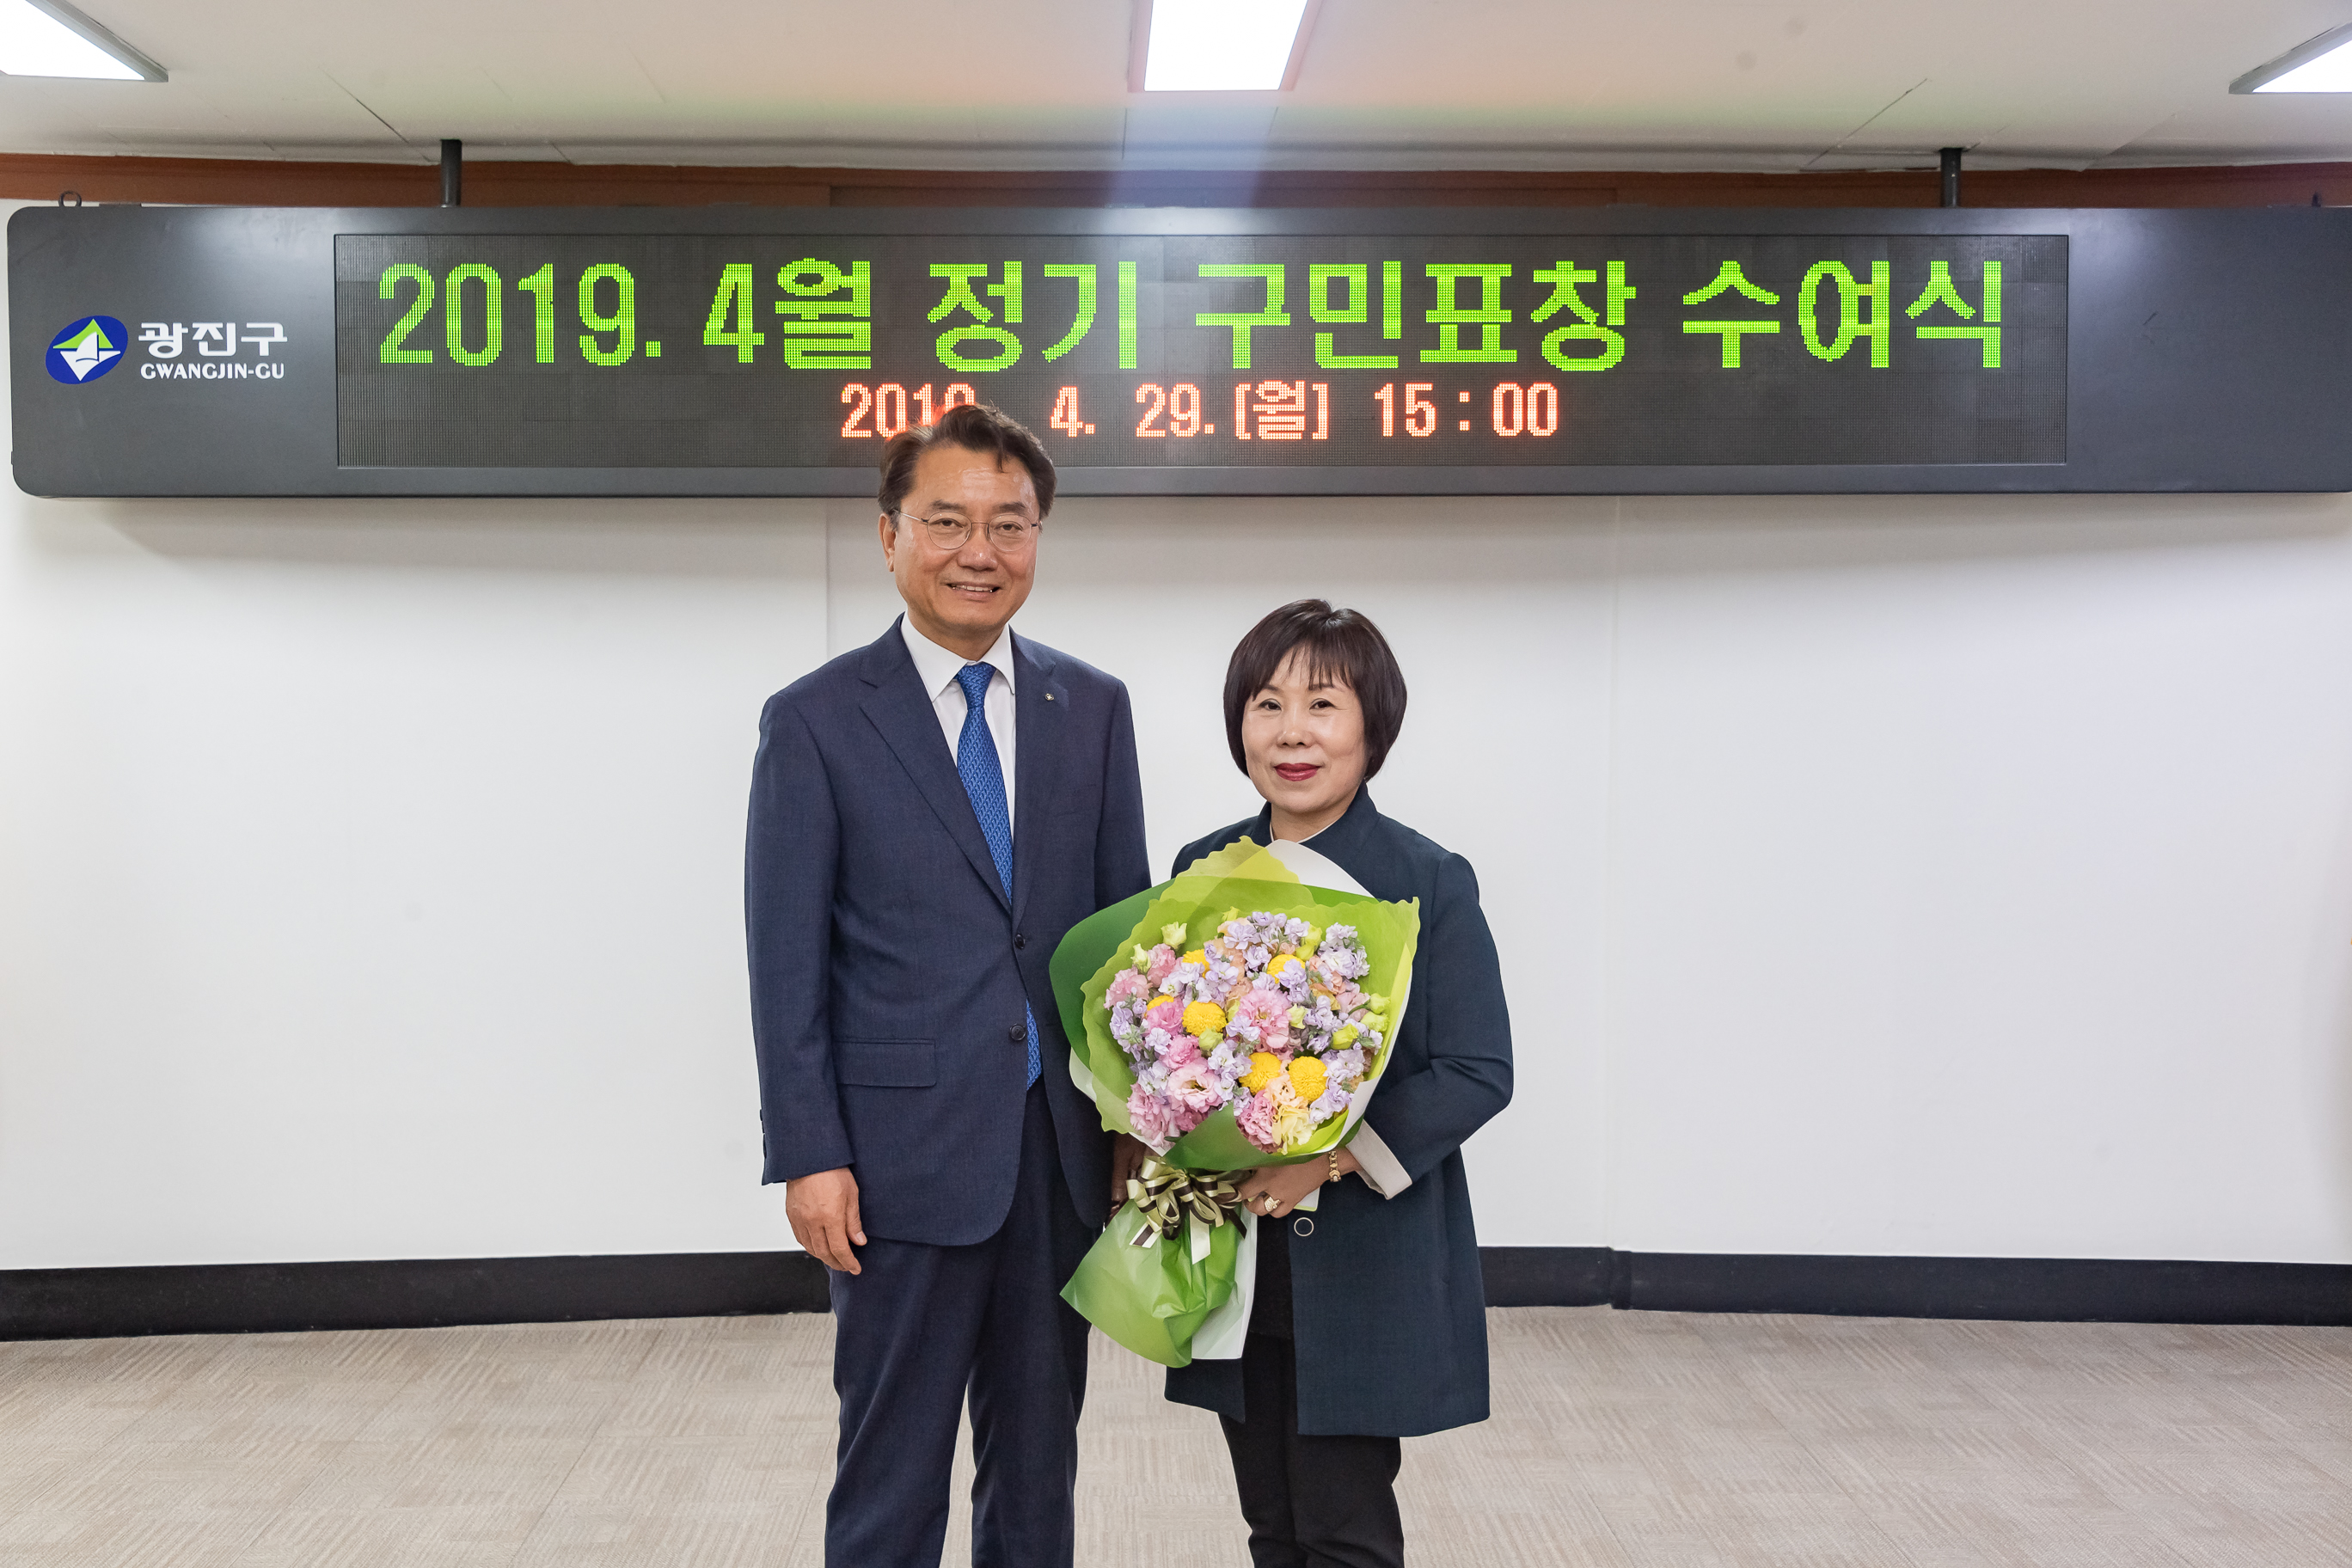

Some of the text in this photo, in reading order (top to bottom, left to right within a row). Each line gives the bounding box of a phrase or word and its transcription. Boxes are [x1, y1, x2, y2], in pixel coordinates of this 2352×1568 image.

[378, 257, 2002, 372] 2019. 4월 정기 구민표창 수여식
[138, 322, 288, 358] 광진구
[140, 362, 285, 380] GWANGJIN-GU
[1050, 385, 1096, 438] 4.
